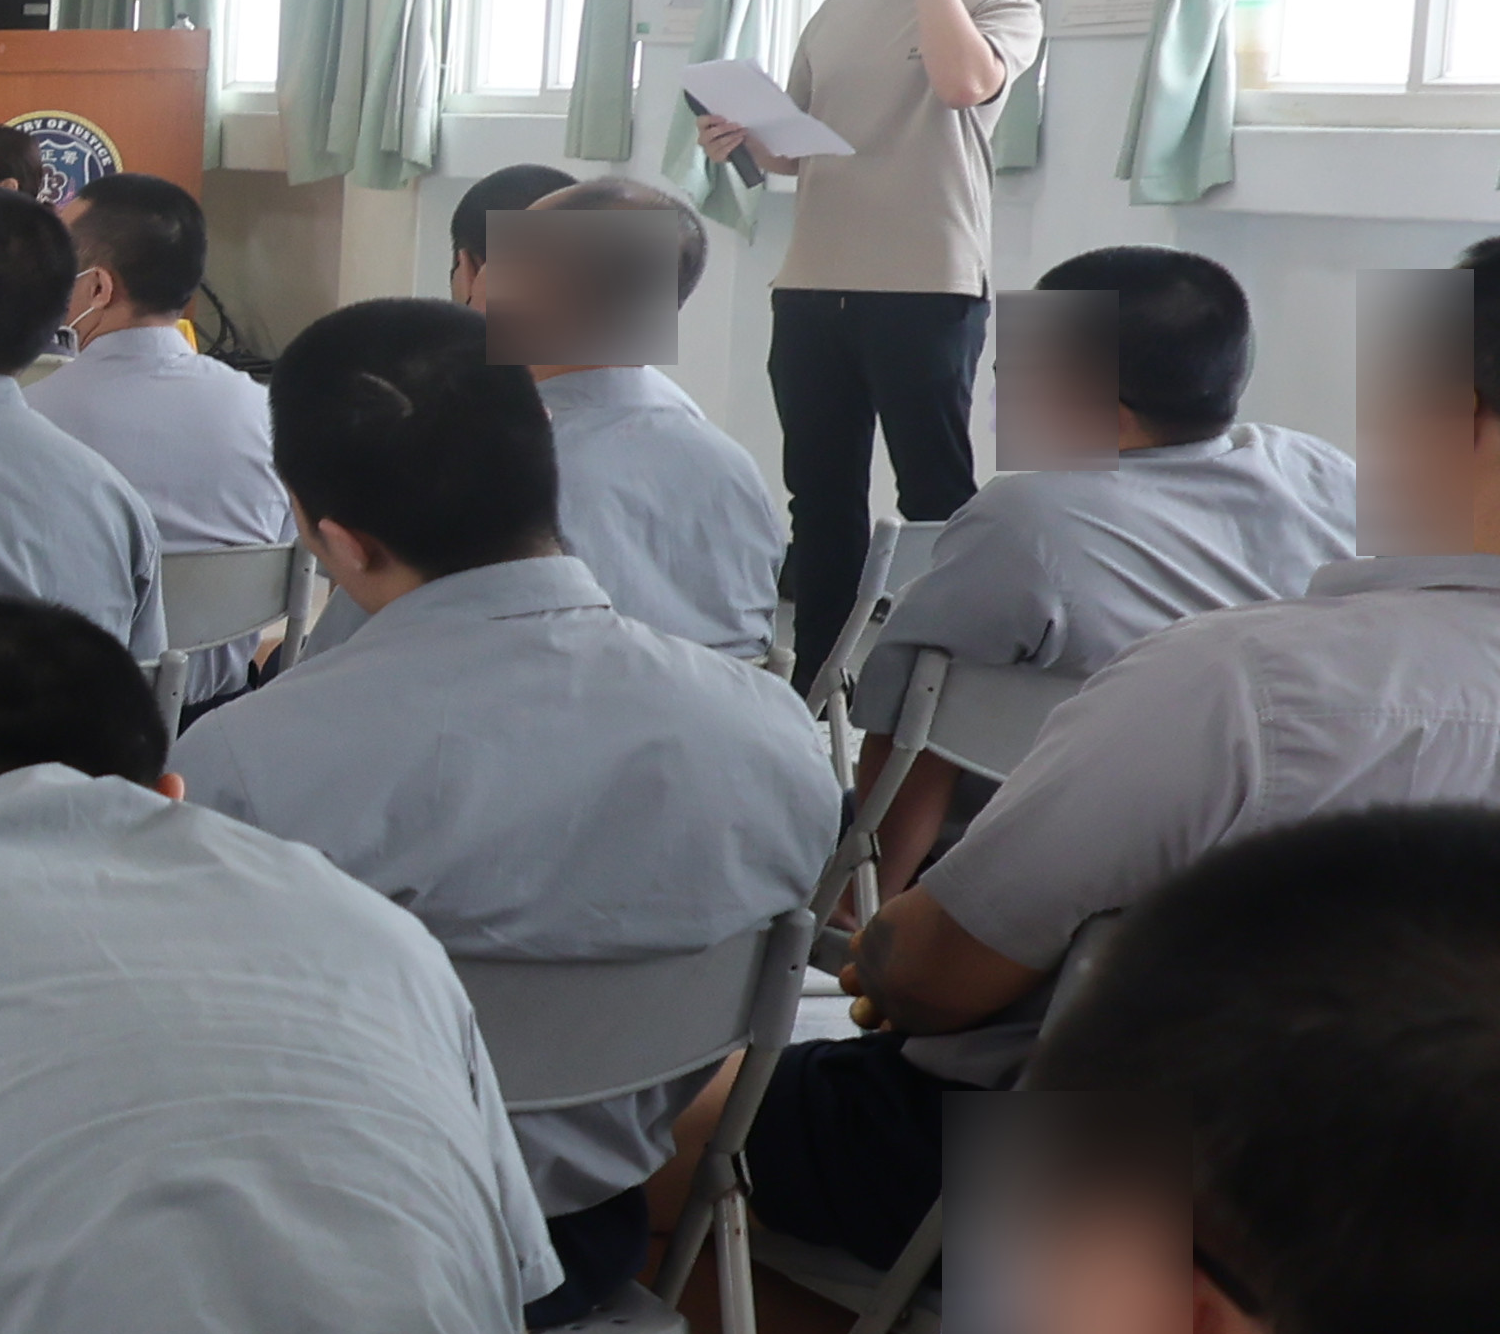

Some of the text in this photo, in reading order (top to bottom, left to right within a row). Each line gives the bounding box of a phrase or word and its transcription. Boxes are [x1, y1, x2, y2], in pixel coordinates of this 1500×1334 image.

[41, 150, 78, 164] 正署
[47, 119, 66, 129] OF
[68, 124, 111, 166] JUSTICE
